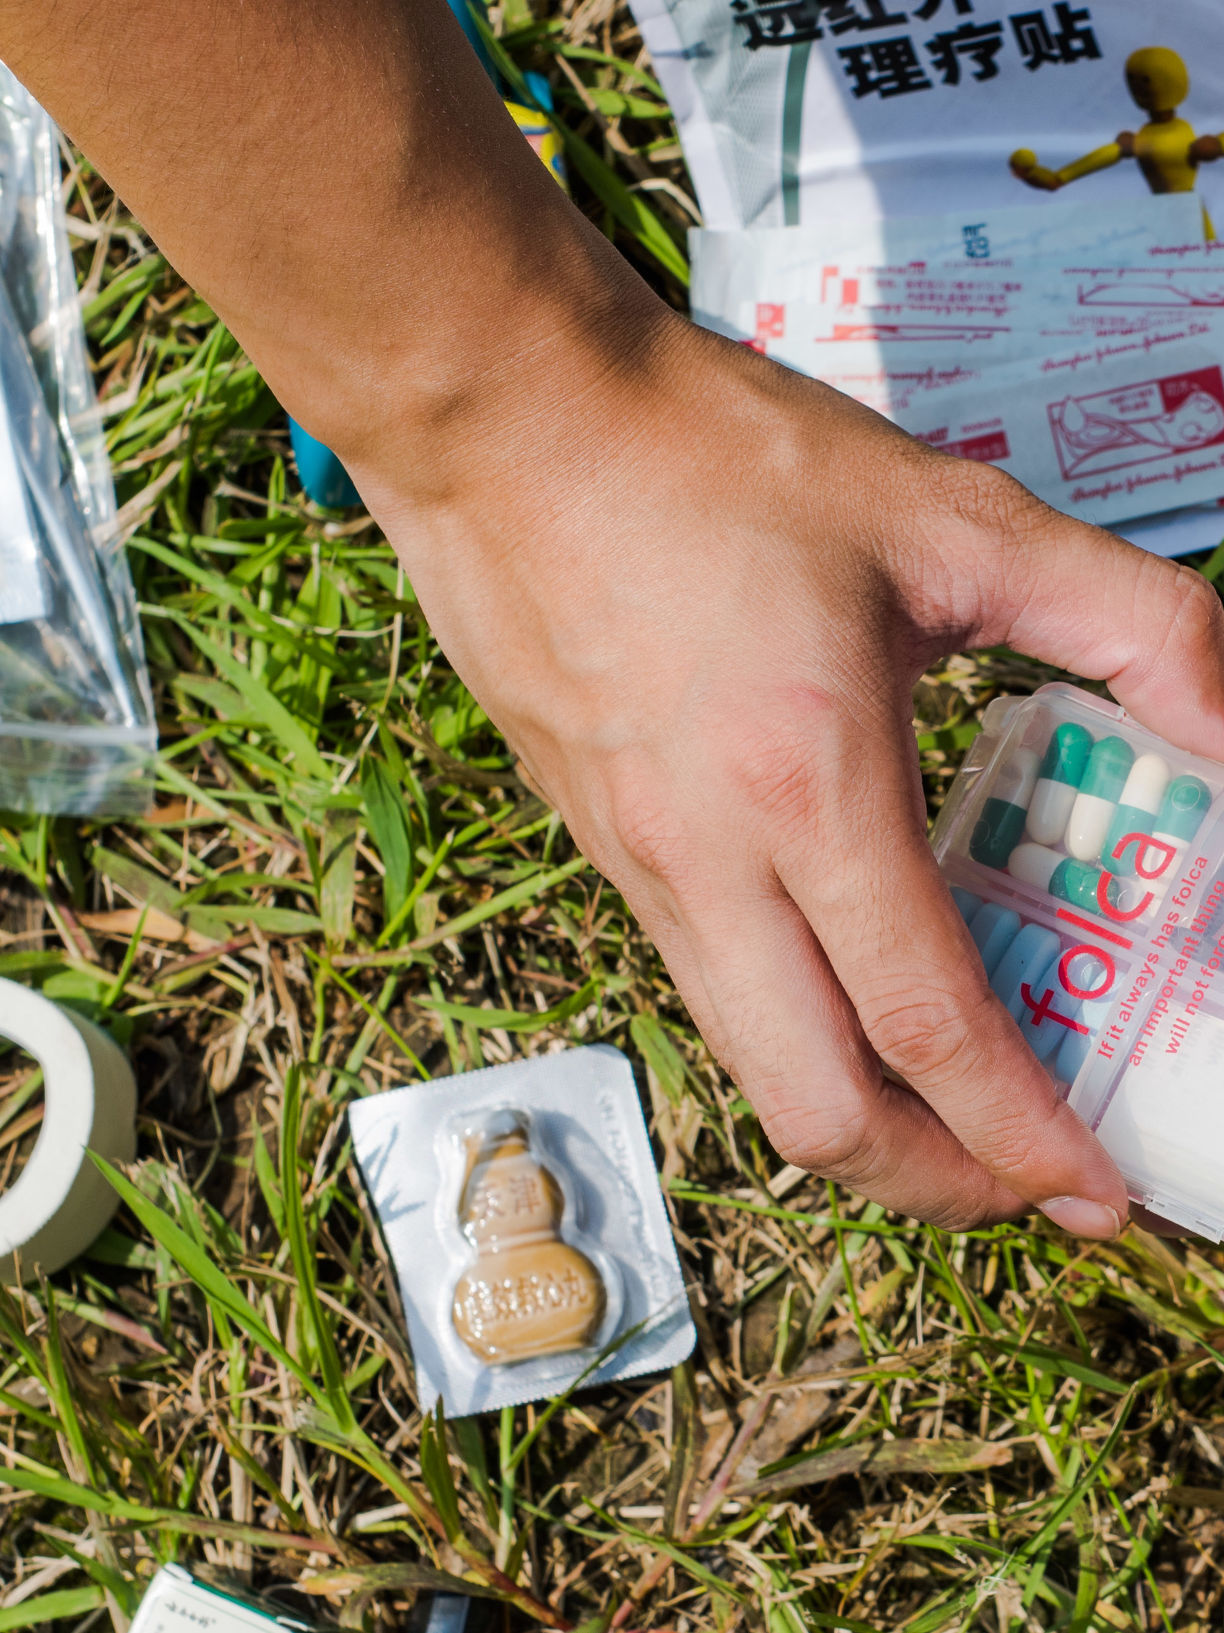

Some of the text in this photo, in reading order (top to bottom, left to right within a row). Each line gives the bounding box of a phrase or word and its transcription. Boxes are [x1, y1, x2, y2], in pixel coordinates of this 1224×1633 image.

[836, 1, 1103, 99] 理疗贴
[1020, 831, 1178, 1037] folca
[1097, 855, 1208, 1060] If it always has folca
[1128, 1040, 1148, 1067] an
[1138, 935, 1201, 1037] important
[1165, 1017, 1191, 1054] will
[1185, 979, 1209, 1016] not
